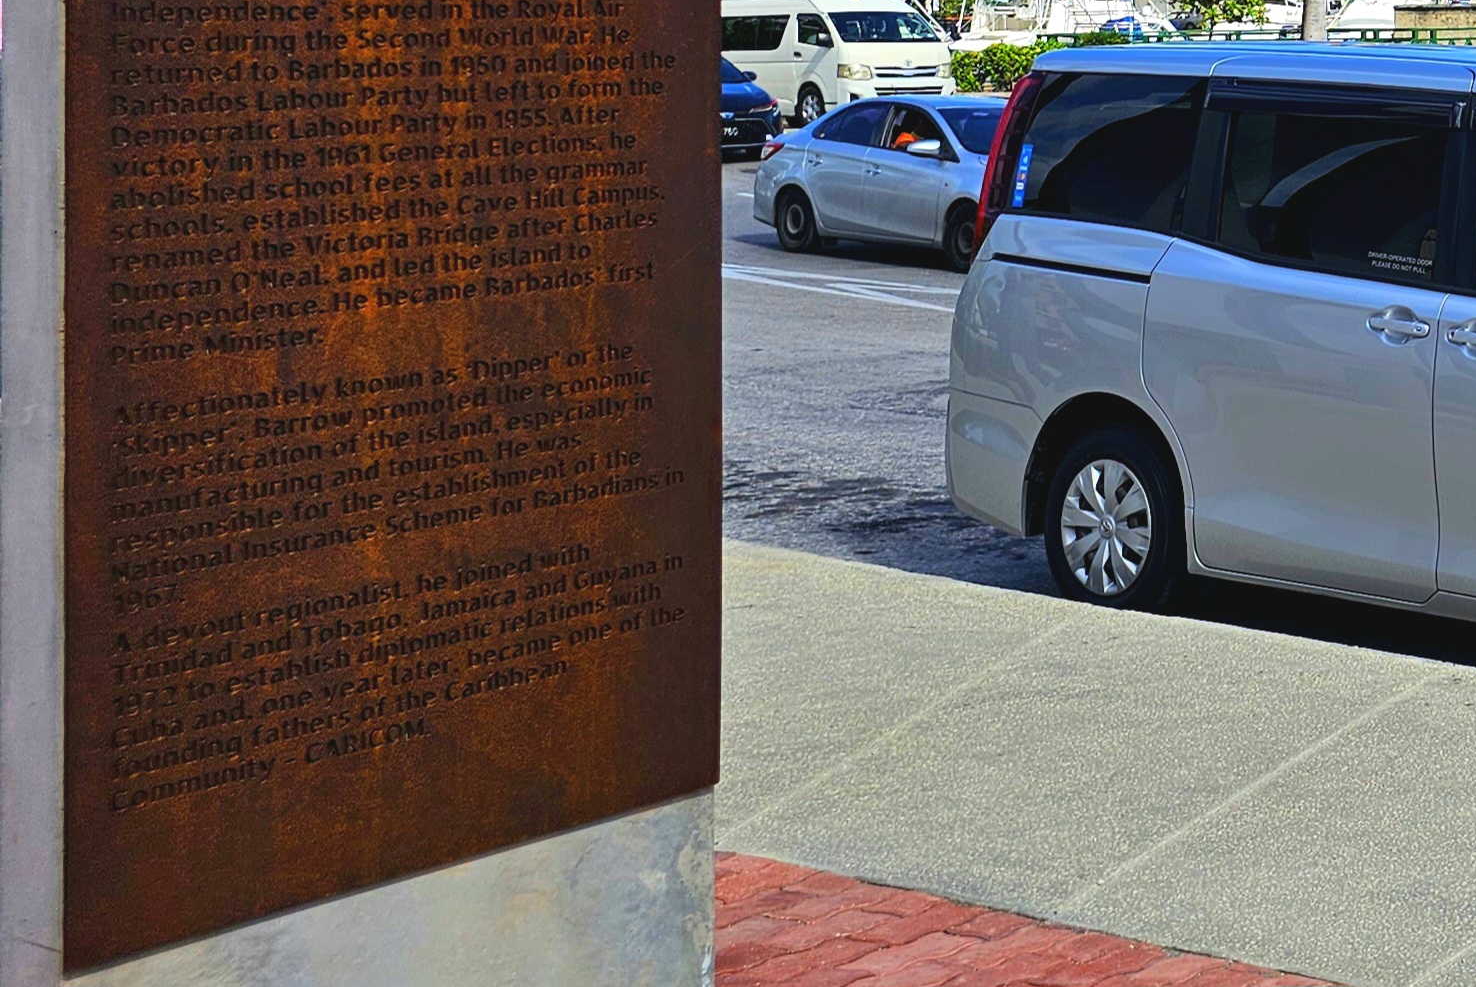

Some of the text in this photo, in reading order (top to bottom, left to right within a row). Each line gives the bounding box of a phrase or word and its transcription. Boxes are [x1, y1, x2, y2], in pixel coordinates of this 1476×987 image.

[341, 0, 433, 21] served
[441, 0, 463, 19] in
[471, 0, 509, 19] the
[110, 50, 676, 86] returned to Barbados in 1950 and joined the
[111, 25, 631, 57] Force during the Second World He
[111, 77, 664, 116] Barbados Labour Party but left to form the
[111, 118, 280, 148] Democratic
[289, 115, 382, 140] Labour
[391, 113, 457, 136] Party
[465, 108, 487, 130] in
[561, 106, 620, 127] After
[111, 155, 220, 182] victory
[229, 150, 253, 172] in
[262, 147, 307, 170] the
[316, 144, 371, 167] 1961
[379, 139, 479, 165] General
[610, 131, 636, 151] he
[111, 159, 646, 209] abolished school fees at all the grammar
[243, 188, 565, 232] established the Cave Hill
[111, 209, 658, 272] renamed the Victoria Bridge after Charles
[1368, 251, 1433, 267] DRIVER-OPERATED DOOR
[1371, 260, 1391, 269] PLEASE
[1391, 263, 1400, 271] DO
[111, 243, 592, 306] Duncan and led the island to
[332, 292, 368, 313] He
[377, 283, 477, 308] became
[607, 261, 654, 284] first
[111, 339, 195, 366] Prime
[114, 343, 633, 426] Affectionately known as or the
[255, 367, 652, 439] Barrow promoted the economic
[111, 393, 653, 491] diversification of the especially in
[111, 473, 321, 519] manufacturing
[331, 459, 380, 486] and
[495, 440, 530, 461] He
[536, 435, 581, 453] was
[112, 449, 641, 552] responsible for the establishment of the
[242, 466, 684, 558] Insurance Scheme for Barbadians in
[113, 552, 683, 685] Trinidad and Jamaica and Guyana in
[142, 544, 590, 650] devout he joined with
[227, 582, 661, 692] establish diplomatic relations with
[262, 605, 685, 714] one year became one of the
[112, 660, 567, 777] founding fathers of the Caribbean
[112, 757, 275, 811] Community
